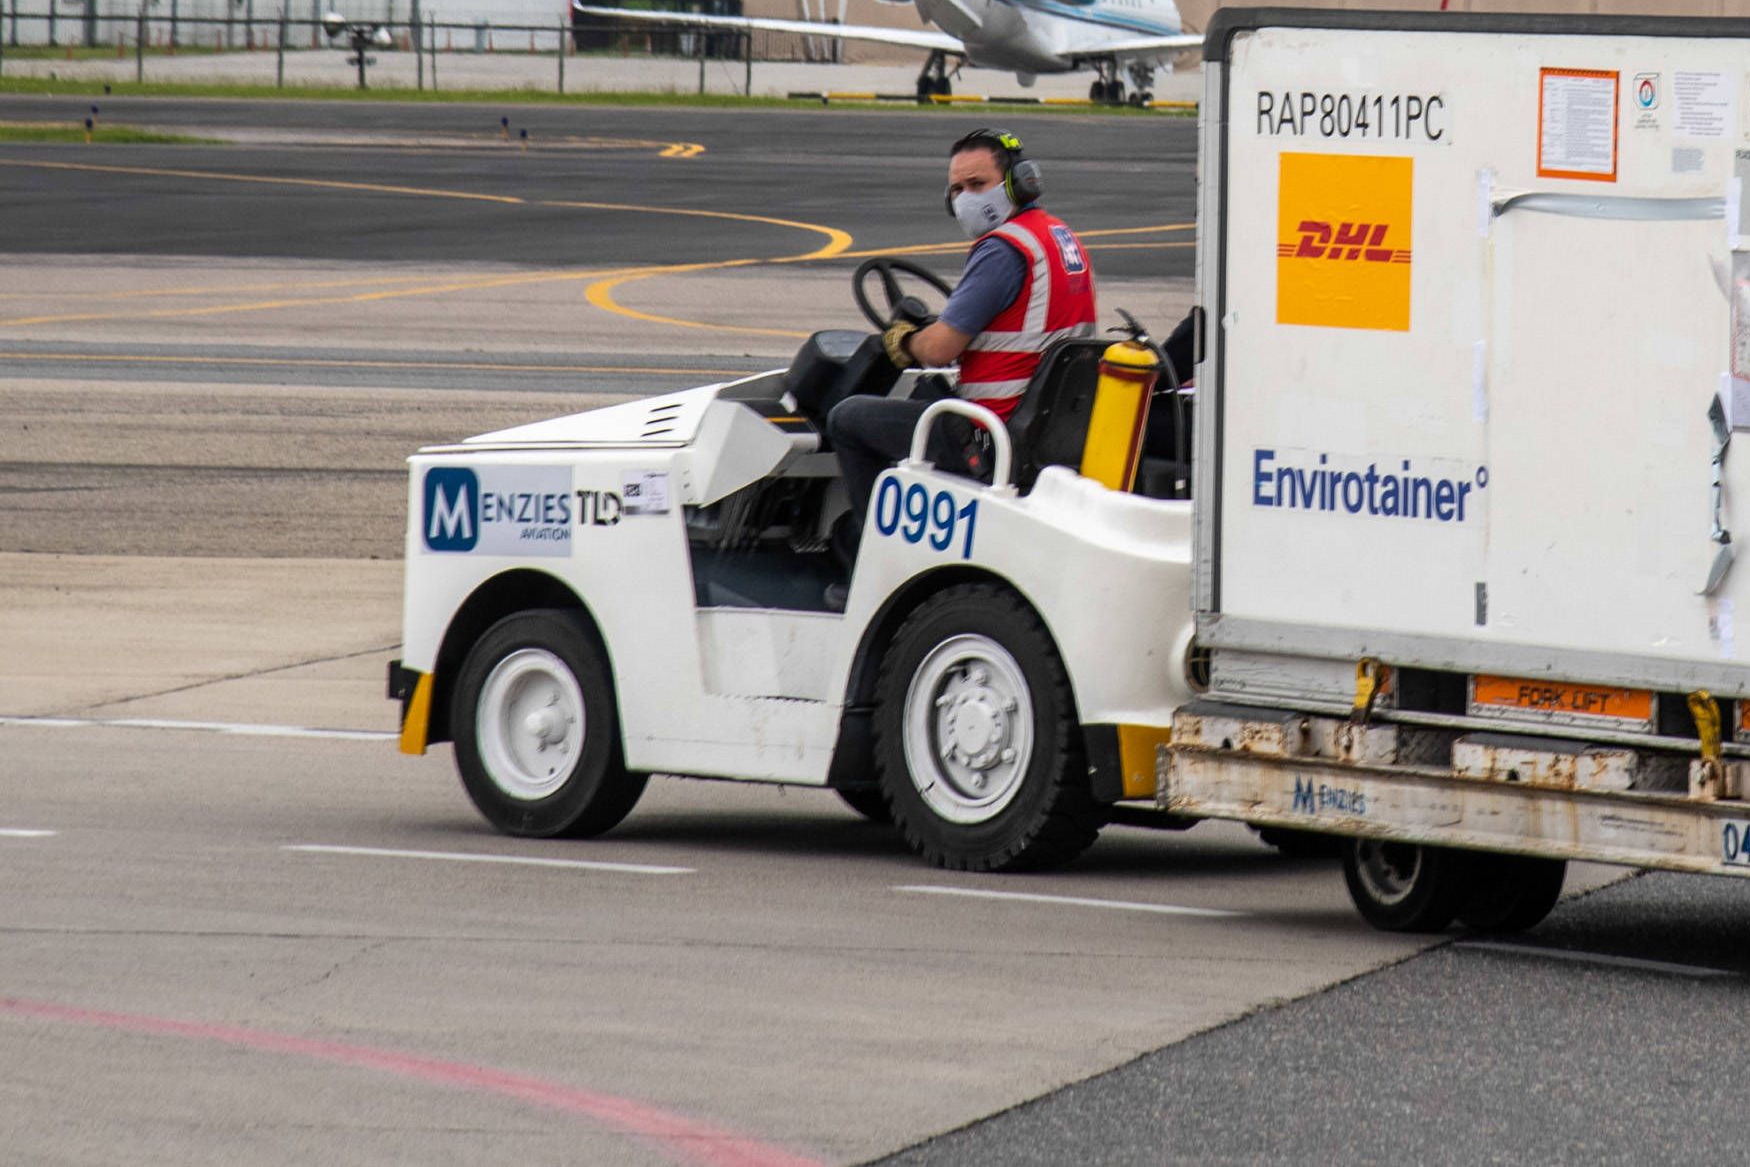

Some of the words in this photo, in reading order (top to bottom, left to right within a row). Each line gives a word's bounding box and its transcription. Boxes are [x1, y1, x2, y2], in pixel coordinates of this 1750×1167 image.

[1257, 91, 1444, 141] RAP80411PC
[1297, 221, 1394, 263] DHL
[576, 490, 625, 527] TLD
[875, 475, 980, 561] 0991
[1517, 685, 1568, 708] FORK
[1572, 690, 1612, 712] LIFT
